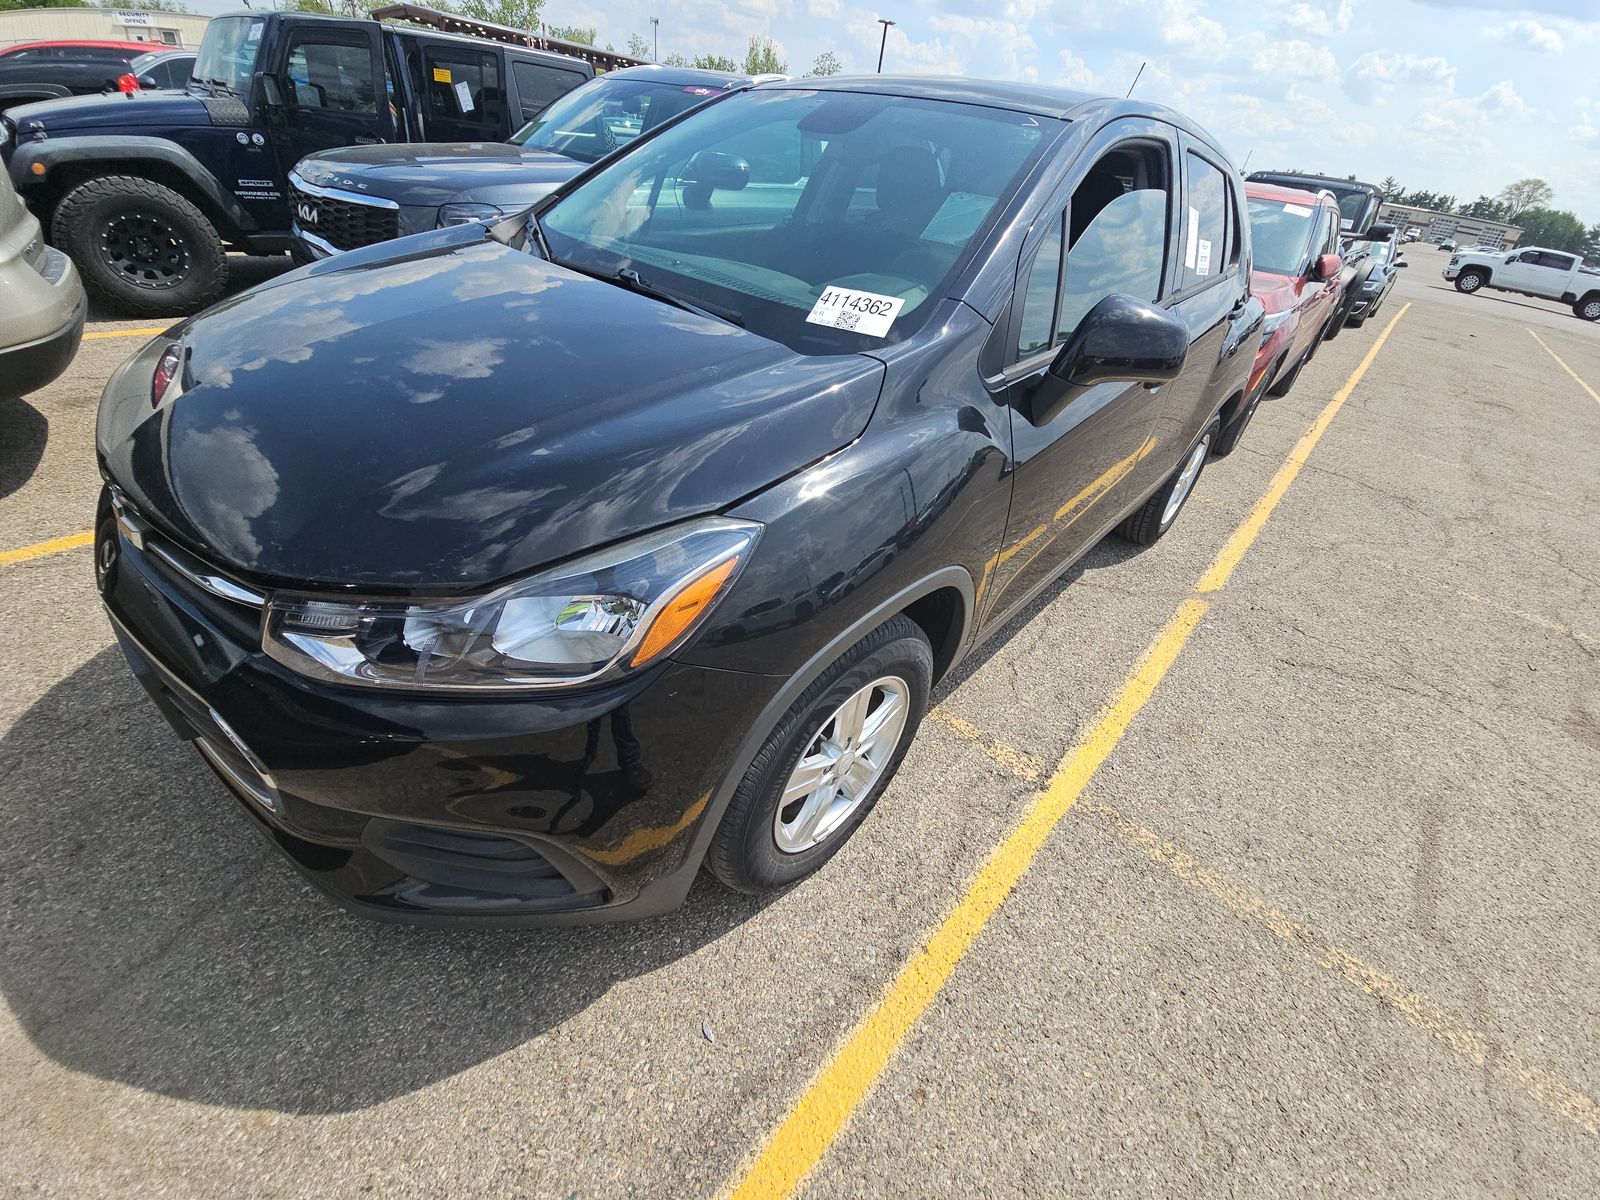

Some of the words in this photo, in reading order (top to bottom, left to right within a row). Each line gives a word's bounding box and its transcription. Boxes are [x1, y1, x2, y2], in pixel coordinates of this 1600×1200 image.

[695, 88, 710, 96] ally
[298, 203, 318, 224] KIA
[820, 291, 893, 317] 4114362
